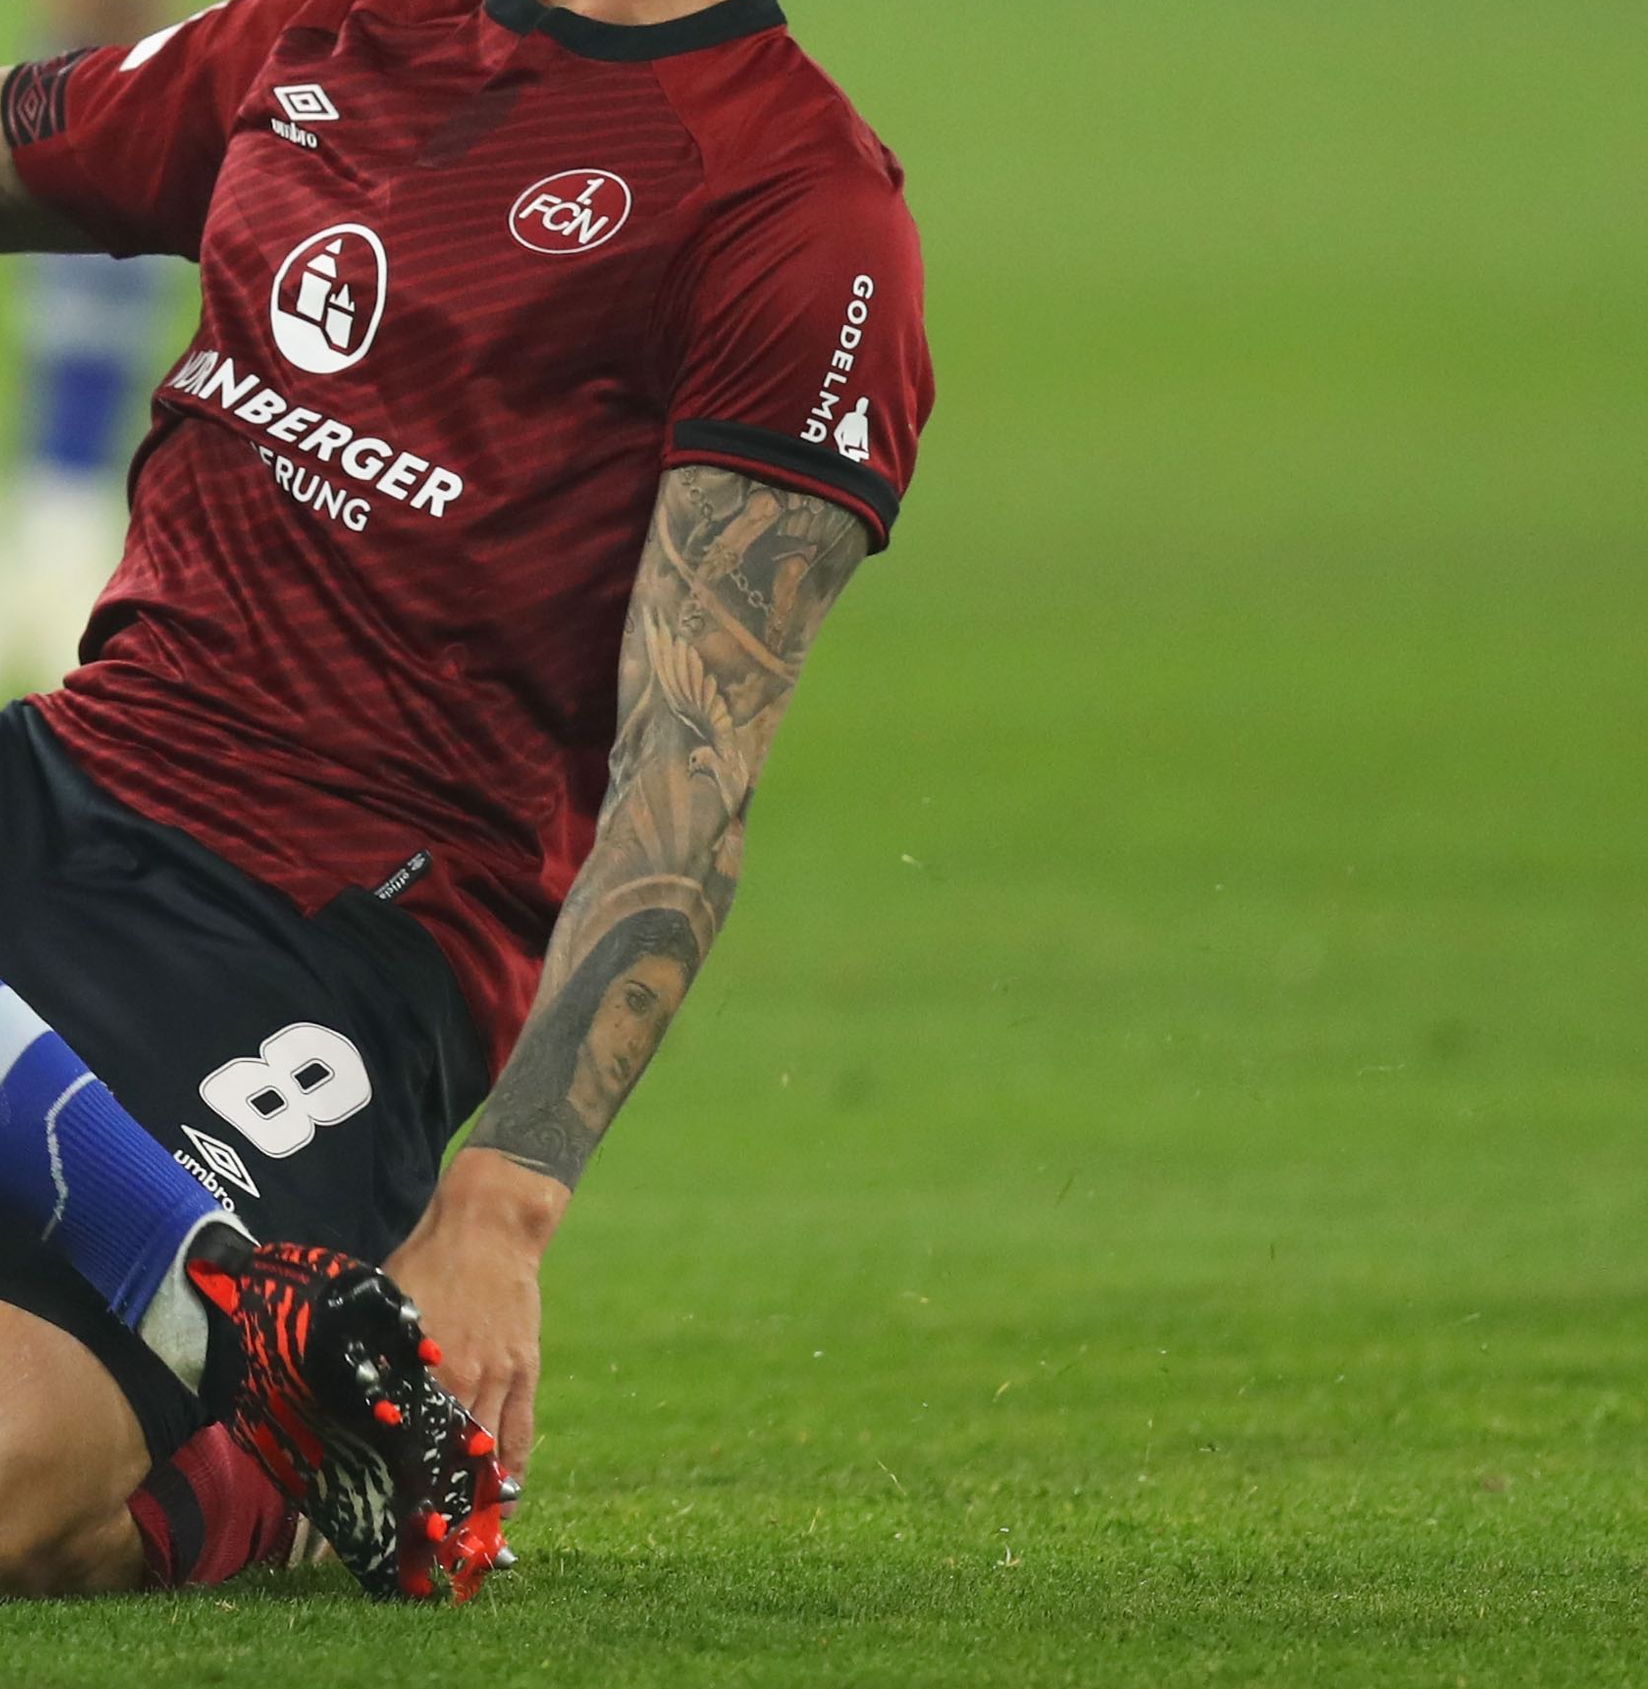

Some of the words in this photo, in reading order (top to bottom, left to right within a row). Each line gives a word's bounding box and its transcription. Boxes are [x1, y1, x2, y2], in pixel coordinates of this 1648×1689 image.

[519, 193, 609, 244] FCN
[800, 274, 874, 444] GODELMA
[199, 1022, 372, 1159] 8
[173, 1149, 235, 1213] umbro
